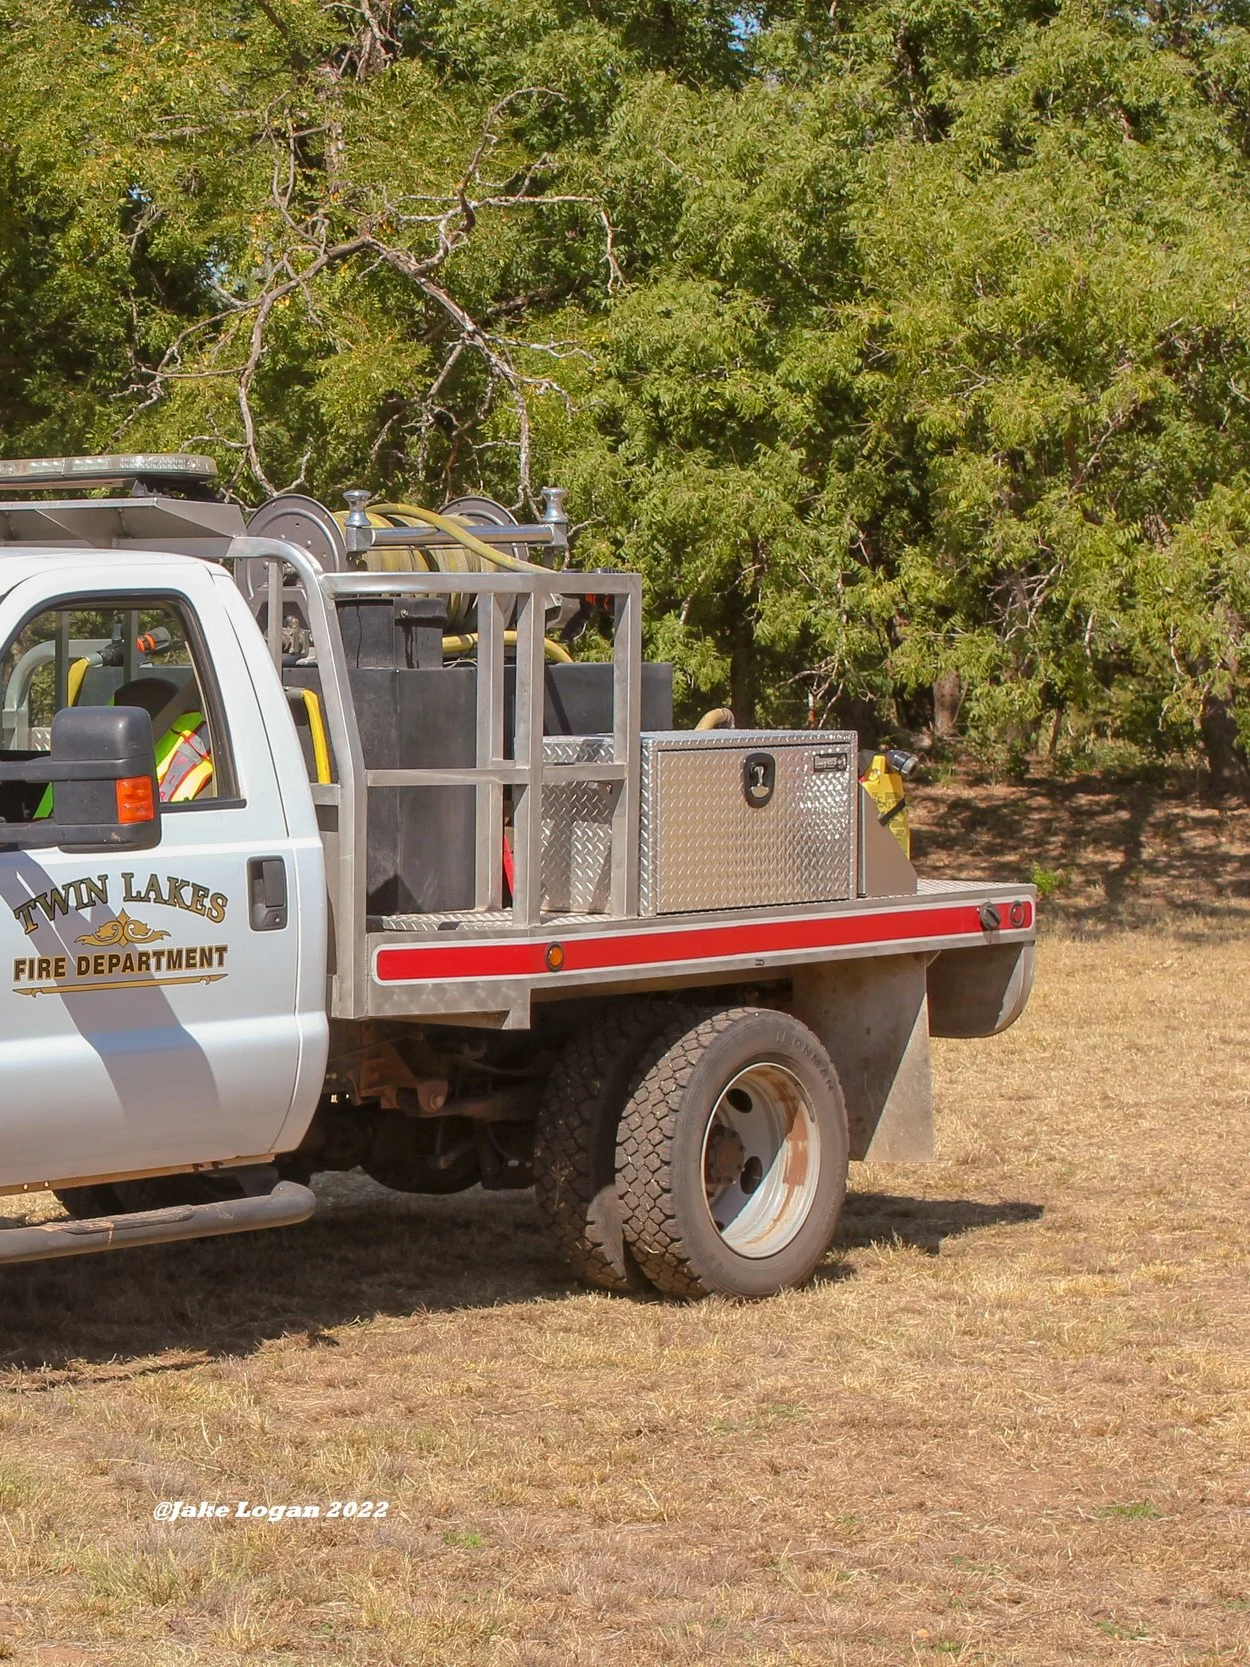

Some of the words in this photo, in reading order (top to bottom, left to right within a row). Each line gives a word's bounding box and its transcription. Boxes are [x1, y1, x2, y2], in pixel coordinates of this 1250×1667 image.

[13, 874, 109, 935] TWIN
[121, 872, 229, 923] LAKES
[13, 956, 66, 981] FIRE
[76, 945, 229, 977] DEPARTMENT
